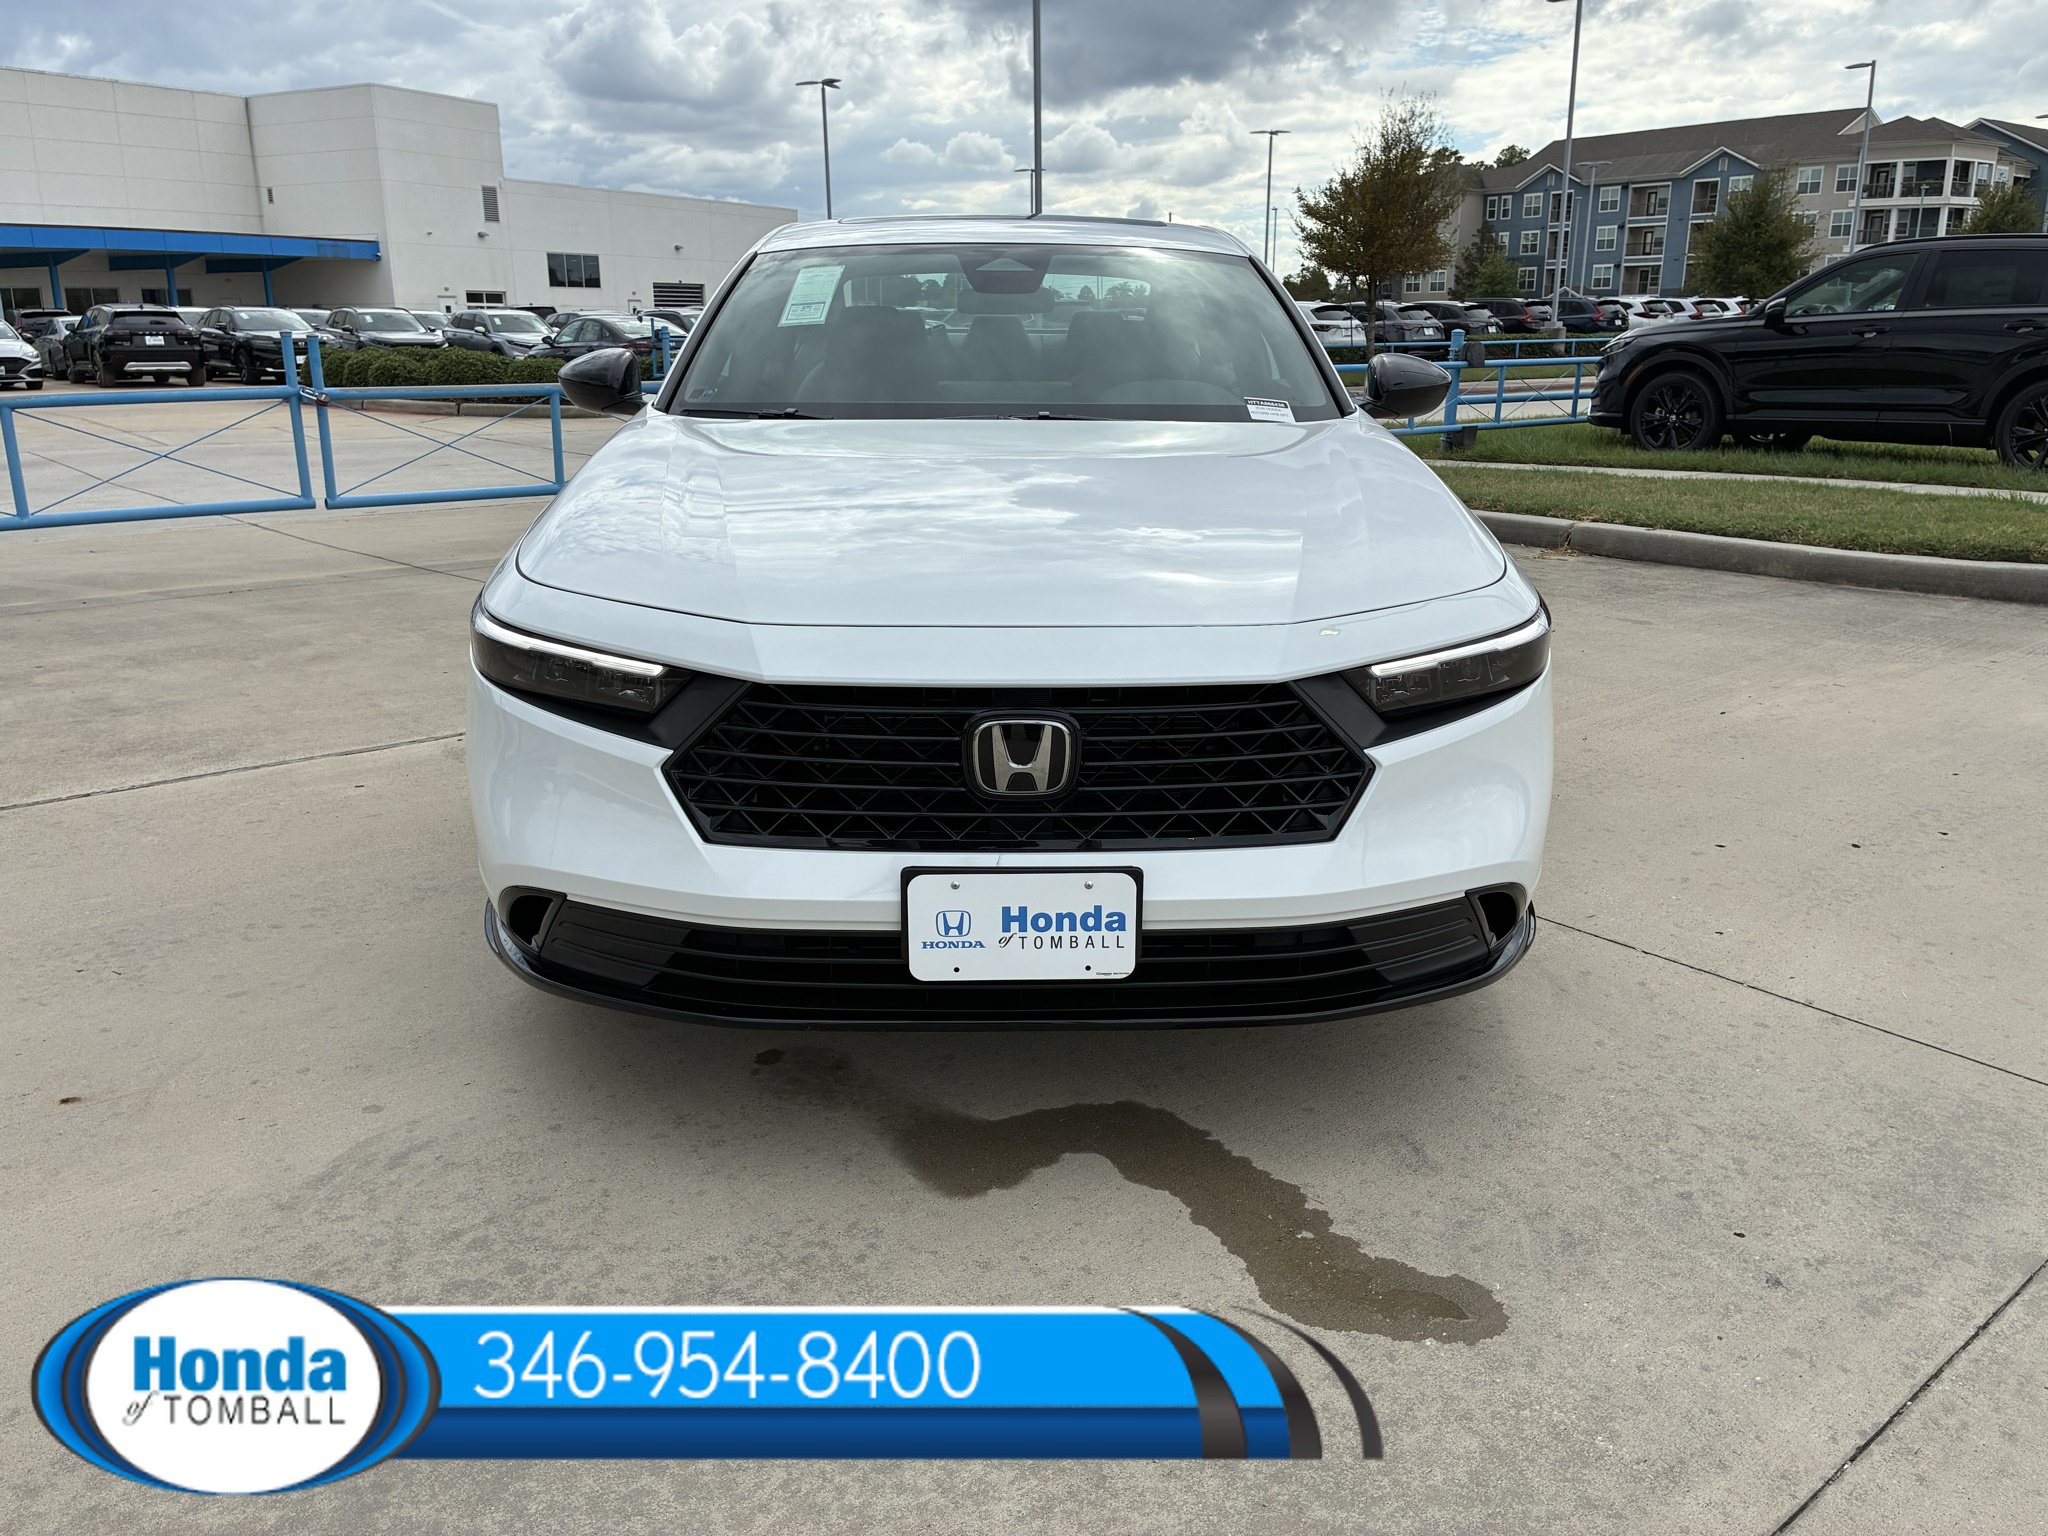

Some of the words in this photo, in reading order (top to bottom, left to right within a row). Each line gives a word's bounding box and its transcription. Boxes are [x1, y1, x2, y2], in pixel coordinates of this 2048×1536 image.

[1001, 905, 1127, 933] Honda
[921, 940, 986, 949] HONDA
[998, 933, 1017, 948] of
[1020, 935, 1125, 950] TOMBALL
